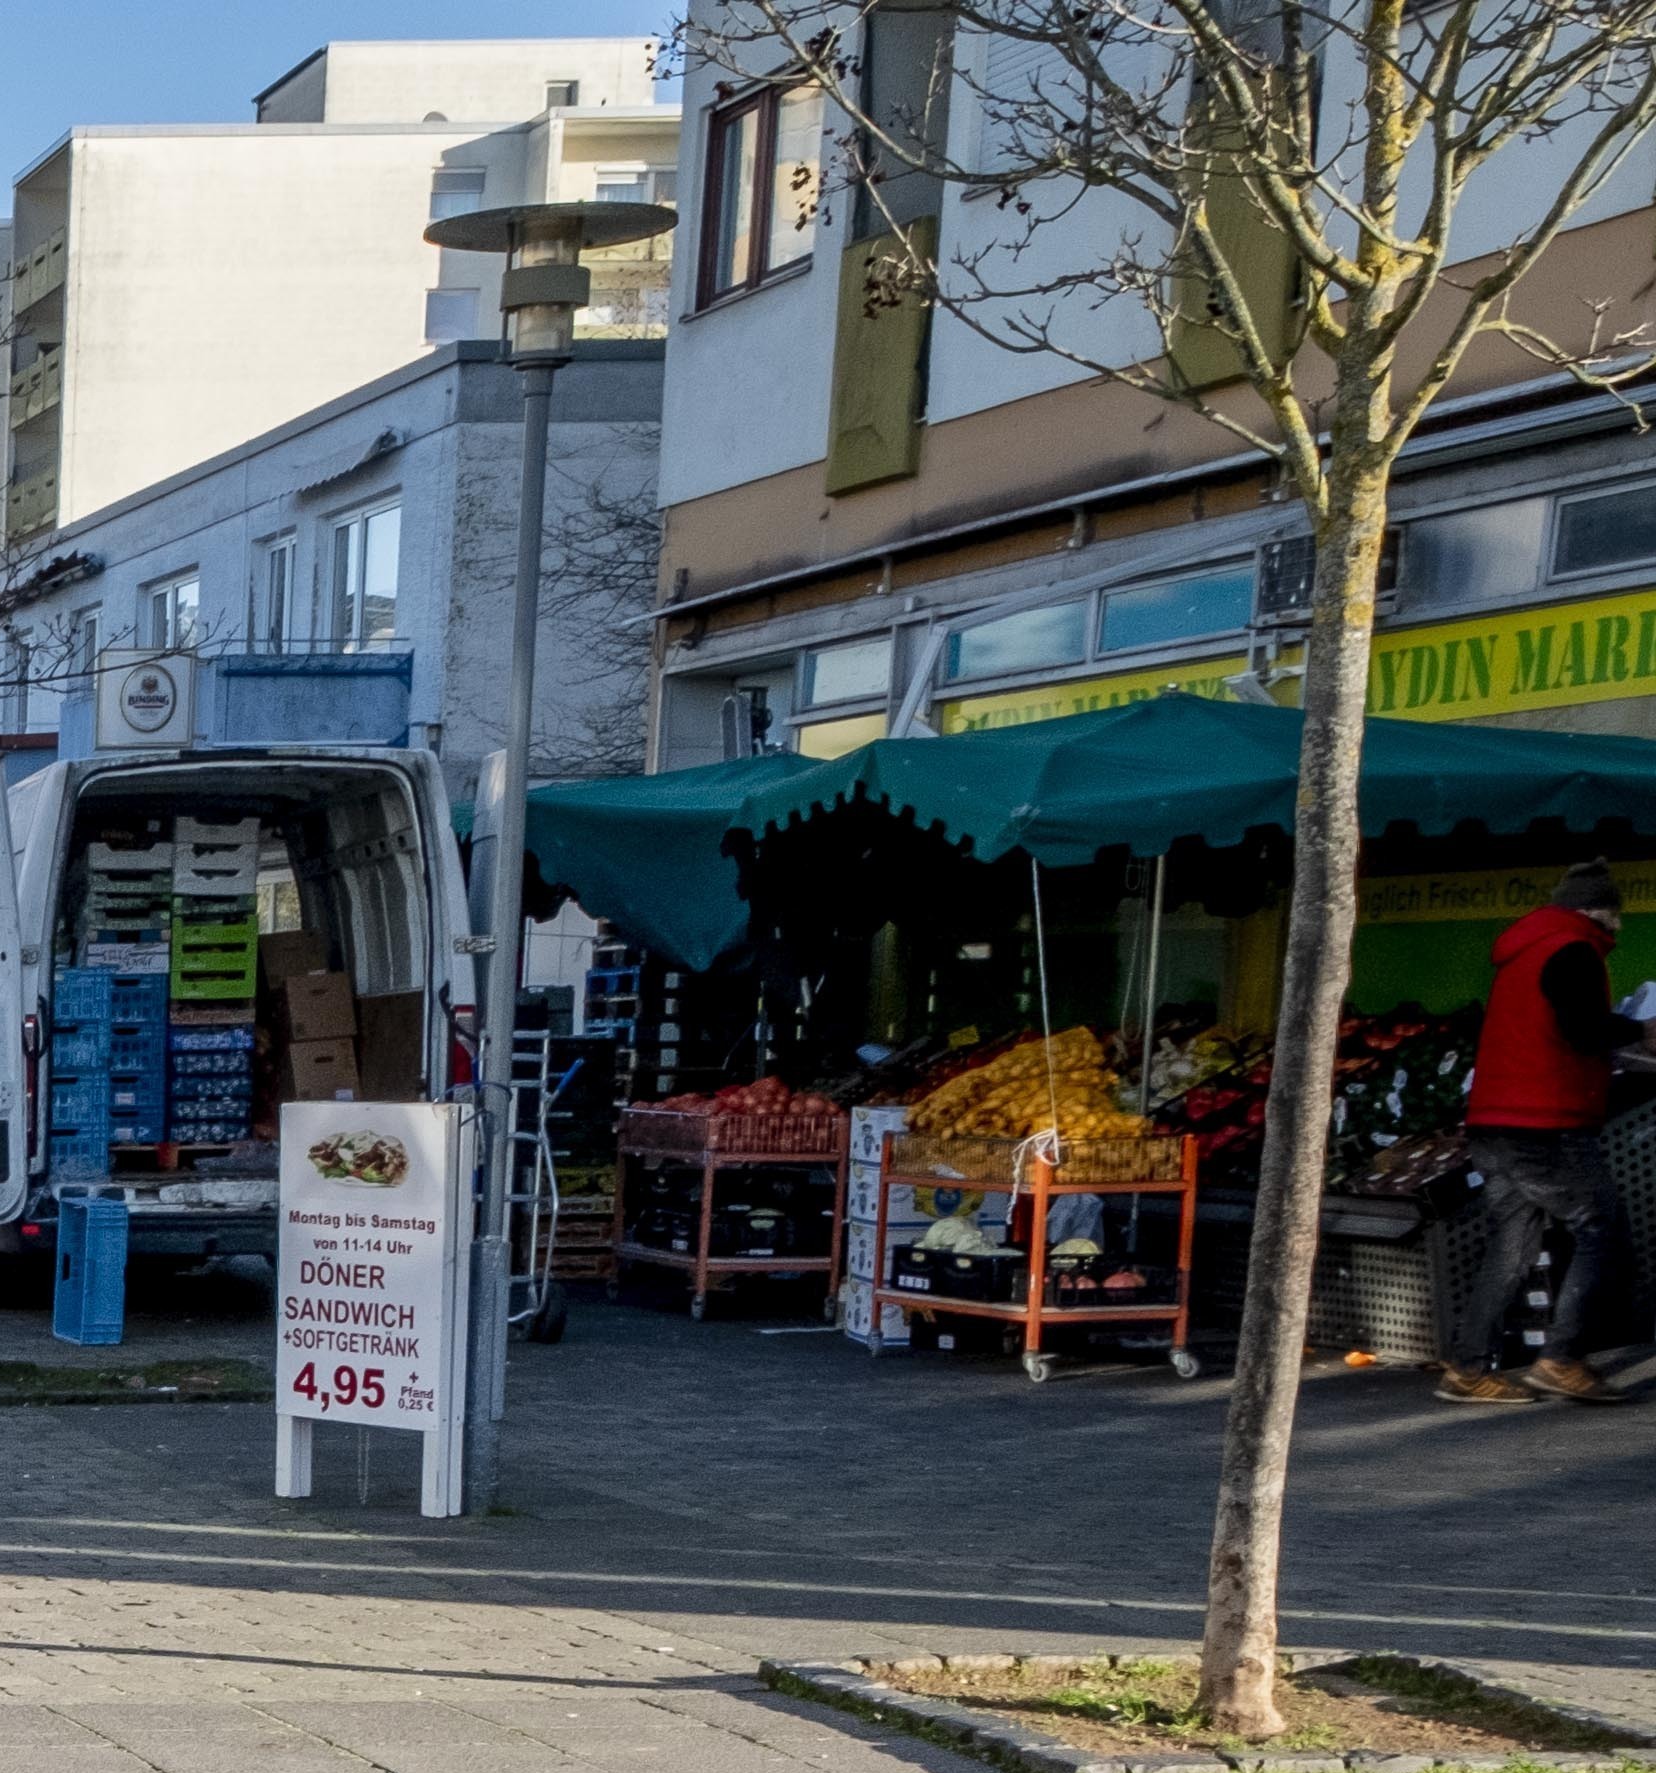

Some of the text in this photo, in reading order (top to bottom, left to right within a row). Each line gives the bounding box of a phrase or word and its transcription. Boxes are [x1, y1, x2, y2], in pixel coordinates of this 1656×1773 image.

[1504, 876, 1554, 907] Obs
[289, 1210, 436, 1234] Montag bis Samstag
[313, 1238, 414, 1255] von 11-14 Uhr
[300, 1256, 385, 1289] DÖNER
[284, 1296, 415, 1330] SANDWICH
[293, 1361, 386, 1412] 4,95
[401, 1385, 434, 1400] Pfand
